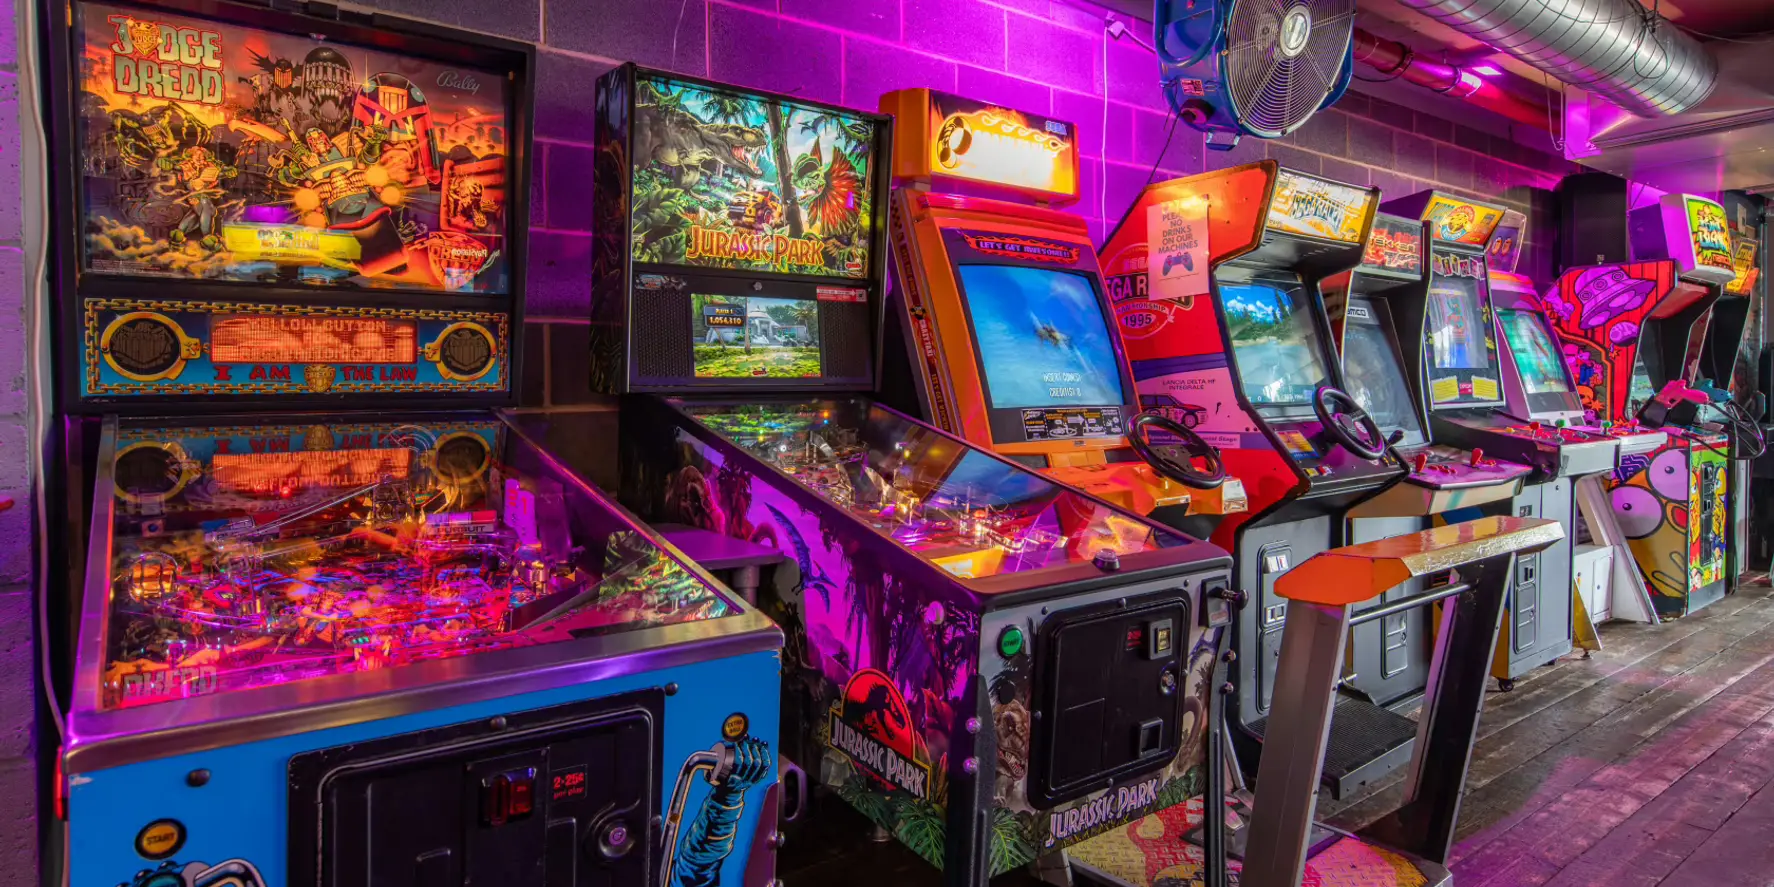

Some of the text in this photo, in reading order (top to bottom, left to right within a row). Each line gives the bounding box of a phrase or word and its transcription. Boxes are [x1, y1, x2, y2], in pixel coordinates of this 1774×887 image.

[109, 15, 222, 69] JDGE
[112, 55, 224, 106] DREDD
[436, 70, 480, 96] Bally
[1045, 120, 1067, 135] SEGA
[1170, 219, 1182, 227] NO
[1162, 225, 1192, 238] DRINKS
[1162, 233, 1193, 246] ON OUR
[686, 225, 825, 267] JURASSIC PARK
[979, 240, 1003, 250] LET'S
[1004, 242, 1021, 252] GET
[1158, 240, 1198, 254] MACHINES
[1370, 235, 1416, 253] TEKKEN
[1123, 313, 1153, 328] 1995
[214, 364, 232, 381] I
[250, 364, 292, 381] AM
[340, 365, 374, 381] THE
[379, 366, 418, 381] LAW
[436, 524, 487, 534] PURSUIT
[831, 715, 926, 799] JURASSIC PARK
[1045, 778, 1158, 848] JURASSIC PARK
